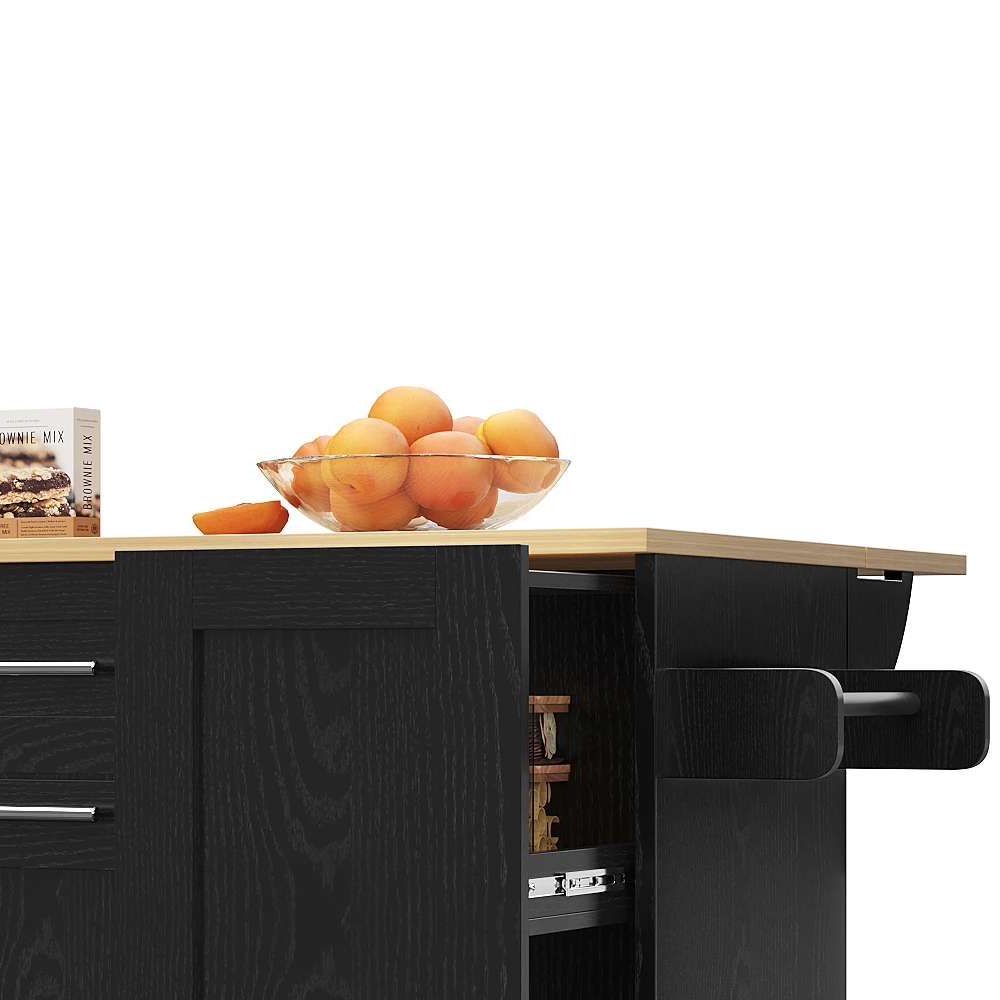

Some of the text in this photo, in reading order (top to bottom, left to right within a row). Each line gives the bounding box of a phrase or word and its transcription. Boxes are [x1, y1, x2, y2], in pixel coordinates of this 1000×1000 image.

[42, 430, 65, 444] MIX
[82, 435, 93, 455] MIX
[82, 460, 93, 510] BROWNIE
